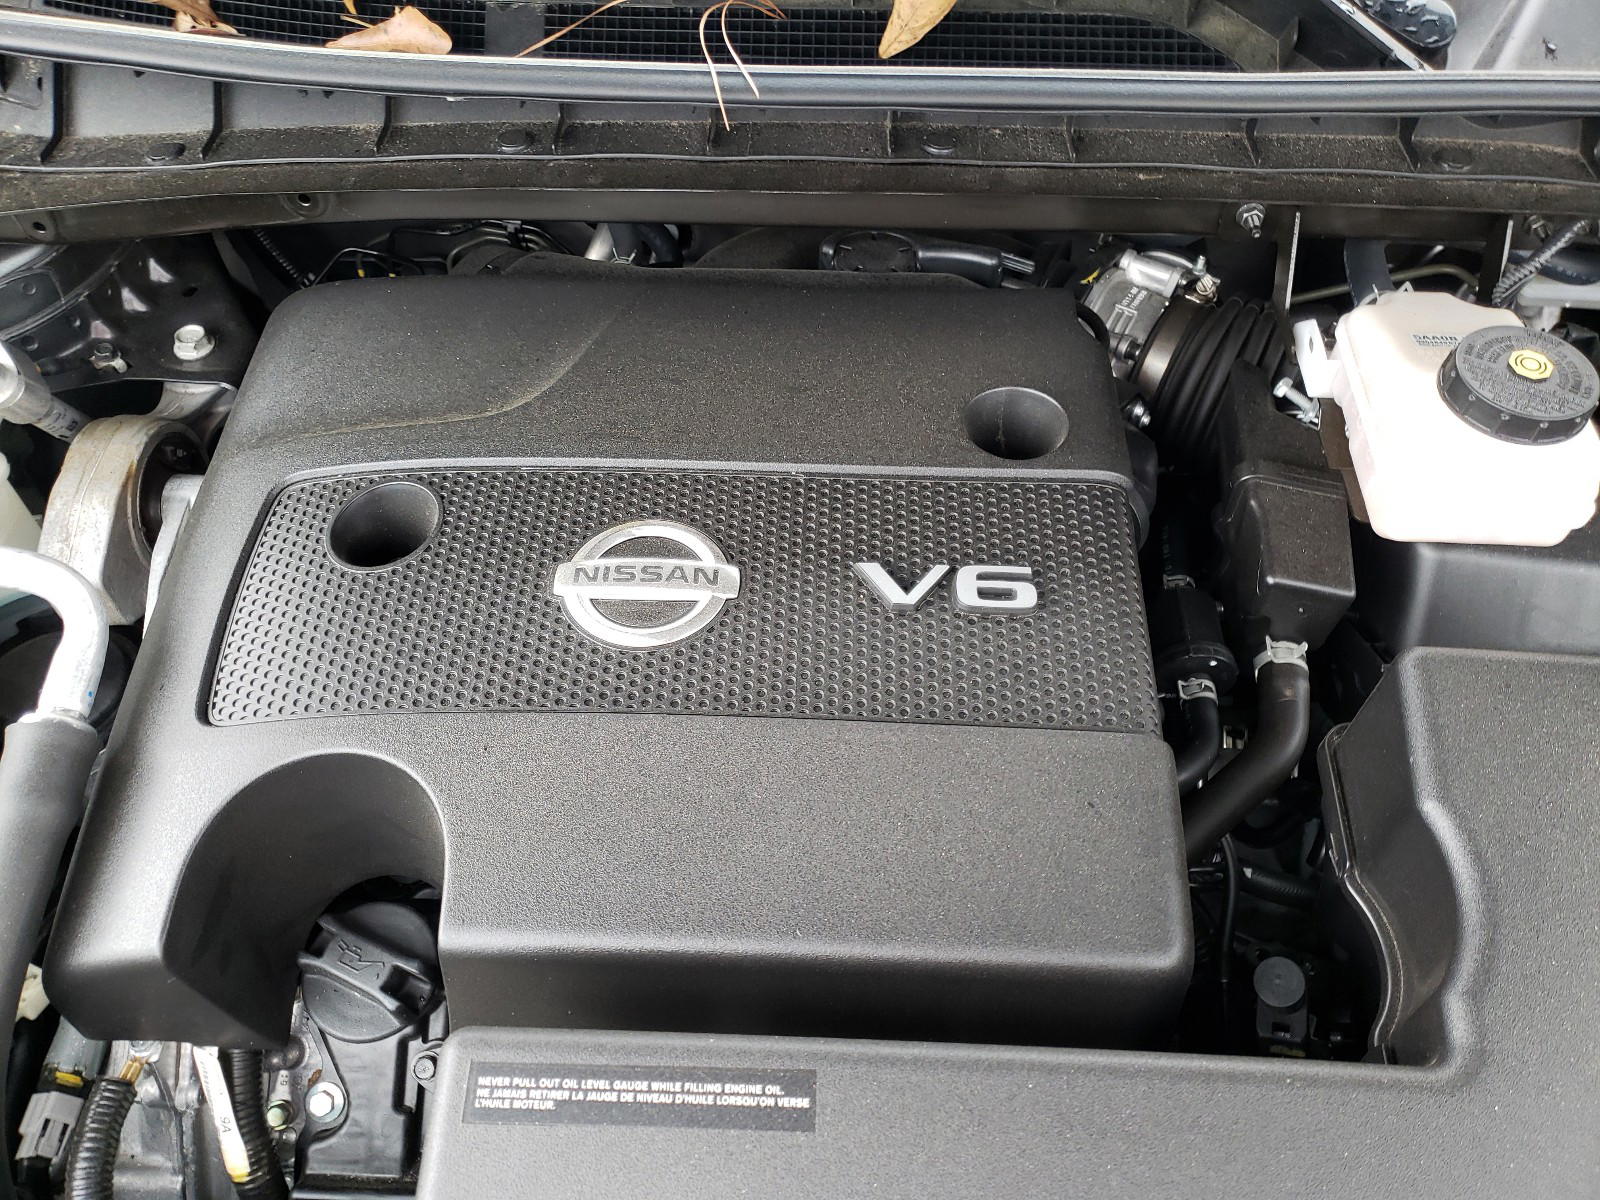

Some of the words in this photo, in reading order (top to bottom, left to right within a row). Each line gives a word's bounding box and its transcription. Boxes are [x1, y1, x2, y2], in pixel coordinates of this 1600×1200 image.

[573, 565, 720, 587] NISSAN
[851, 562, 1038, 613] V6
[477, 1076, 510, 1087] NEVER
[512, 1077, 537, 1088] PULL
[538, 1078, 561, 1089] OUT
[562, 1078, 579, 1089] OIL
[581, 1079, 611, 1090] LEVEL
[613, 1080, 649, 1091] GAUGE
[651, 1081, 683, 1092] WHILE
[684, 1082, 722, 1093] FILLING
[724, 1083, 762, 1094] ENGINE
[764, 1085, 785, 1096] OIL.
[474, 1098, 511, 1109] L'HUILE
[512, 1099, 557, 1110] MOTEUR.
[476, 1088, 491, 1098] NE
[492, 1088, 527, 1099] JAMAIS
[529, 1089, 570, 1100] RETIRER
[571, 1091, 585, 1101] LA
[586, 1091, 618, 1102] JAUGE
[620, 1092, 635, 1103] DE
[636, 1093, 673, 1104] NIVEAU
[674, 1094, 715, 1105] D'HUILE
[716, 1095, 775, 1107] LORSQU'ON
[777, 1097, 810, 1109] VERSE
